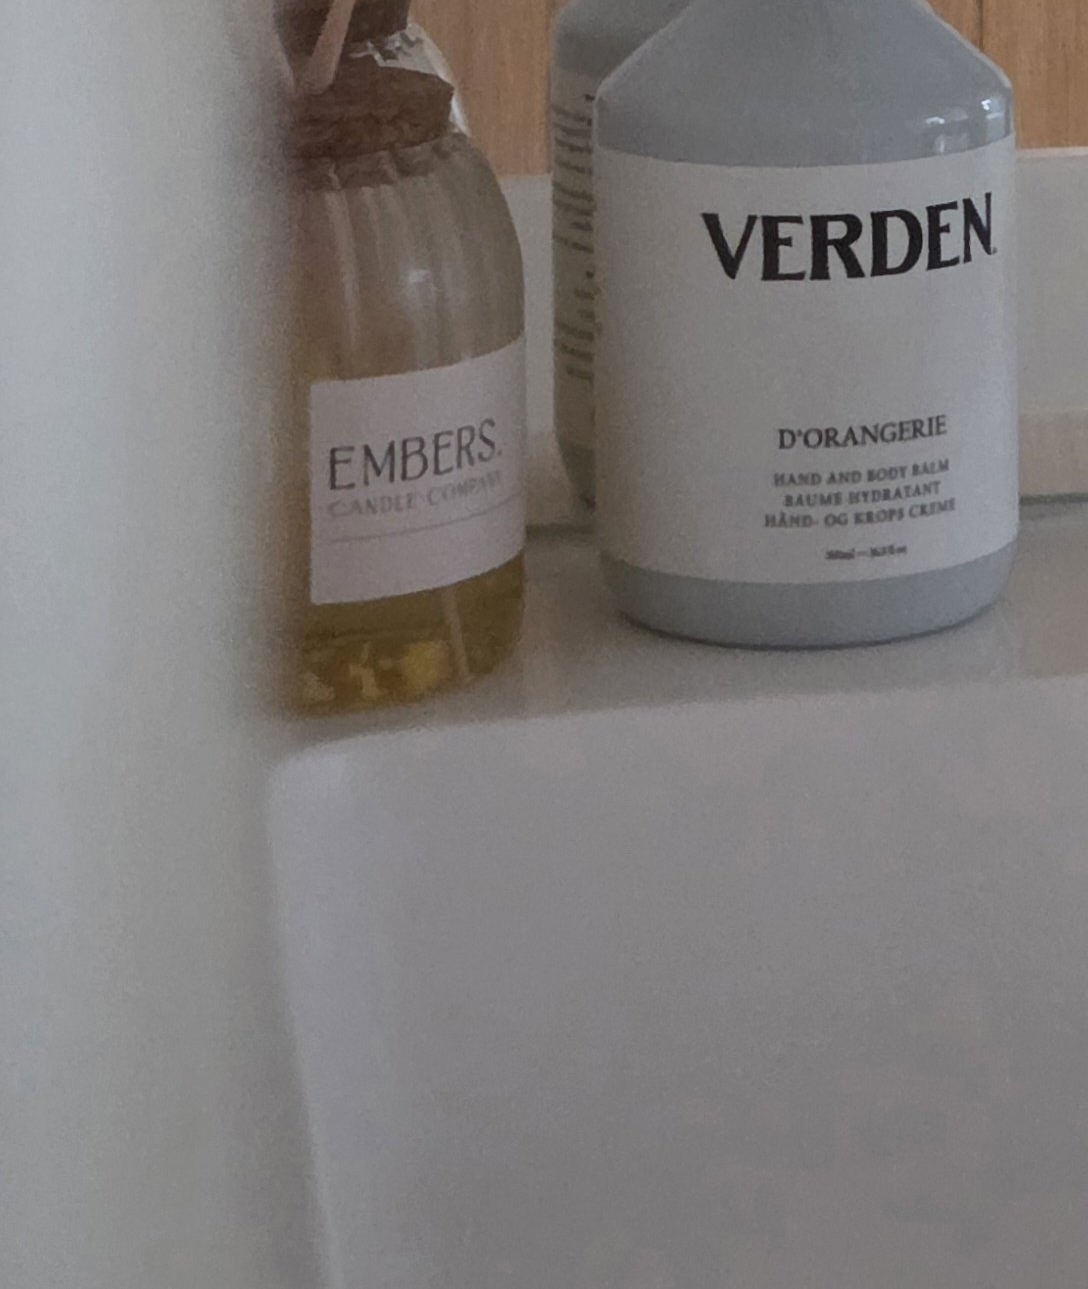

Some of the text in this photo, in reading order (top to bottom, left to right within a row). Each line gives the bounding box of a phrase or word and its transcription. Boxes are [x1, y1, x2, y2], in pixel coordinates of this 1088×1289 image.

[778, 414, 948, 450] D'ORANGERIE
[773, 457, 950, 487] HAND AND BODY BALM
[327, 491, 416, 518] CANDLE
[784, 480, 941, 507] BAUME HYDRATANT
[823, 512, 849, 528] OG
